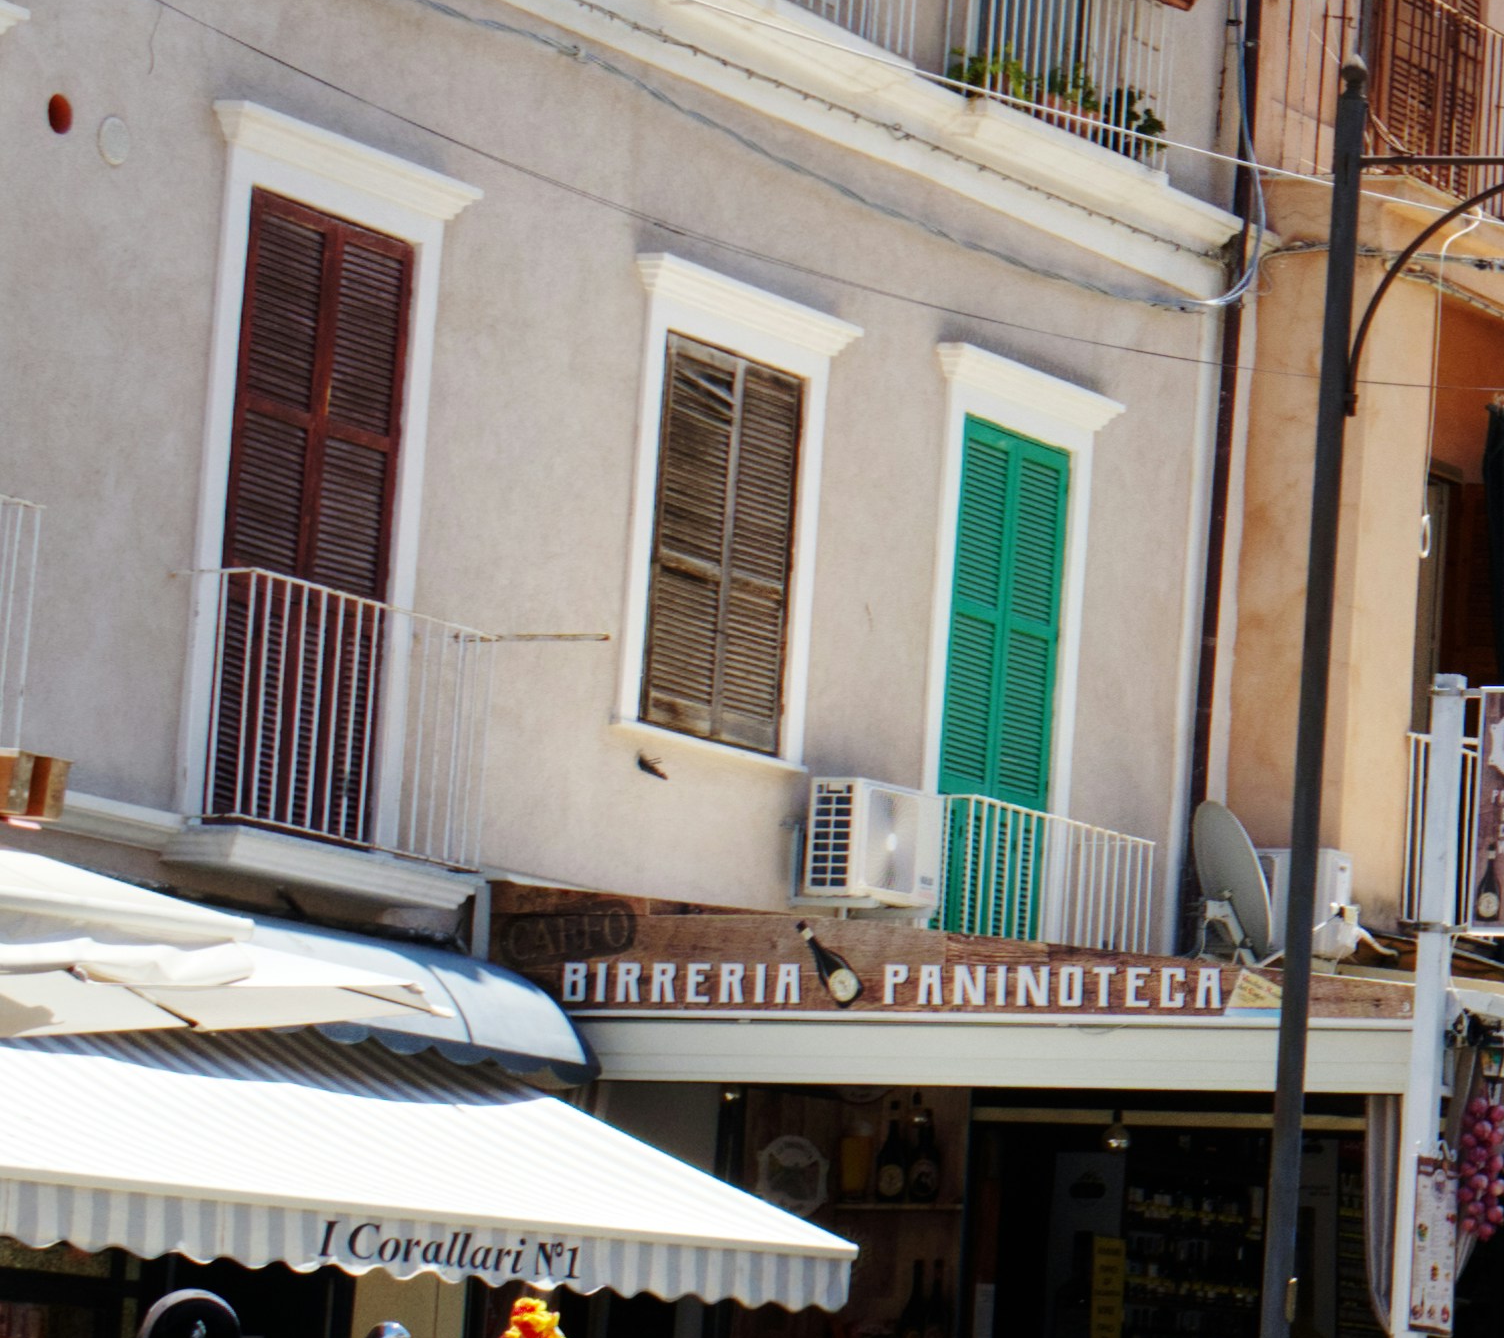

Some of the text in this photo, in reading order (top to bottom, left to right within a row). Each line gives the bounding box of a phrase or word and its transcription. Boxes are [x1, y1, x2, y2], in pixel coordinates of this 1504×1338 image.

[563, 961, 801, 1005] BIRRERIA
[882, 965, 1222, 1010] PANINOTECA
[318, 1219, 336, 1258] I
[347, 1222, 525, 1274] Corallari
